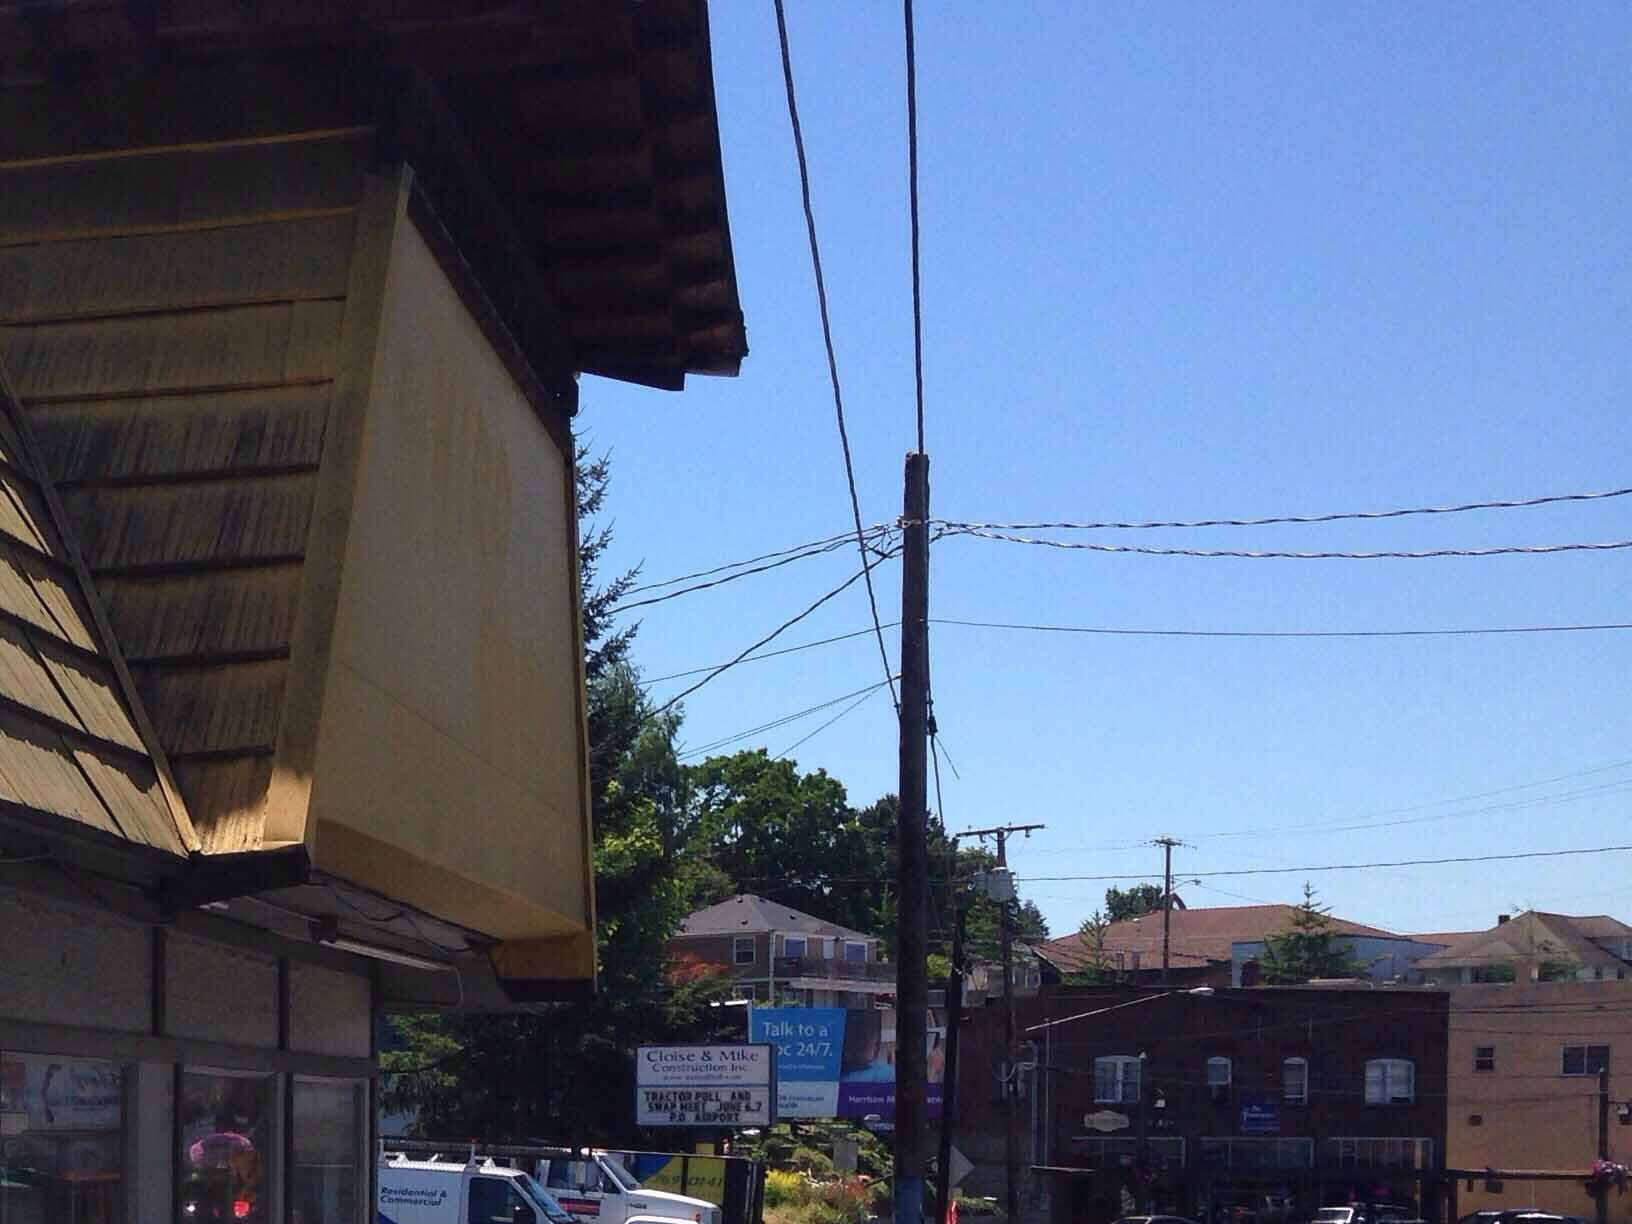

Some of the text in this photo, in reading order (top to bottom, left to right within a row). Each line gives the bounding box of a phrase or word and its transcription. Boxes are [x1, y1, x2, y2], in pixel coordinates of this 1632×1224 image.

[763, 1021, 828, 1037] Talk to a
[701, 1050, 712, 1062] &
[720, 1049, 759, 1062] Mike
[644, 1091, 751, 1102] TRACTOR PULL AND
[381, 1186, 448, 1198] Residential &
[380, 1195, 441, 1207] Commercial
